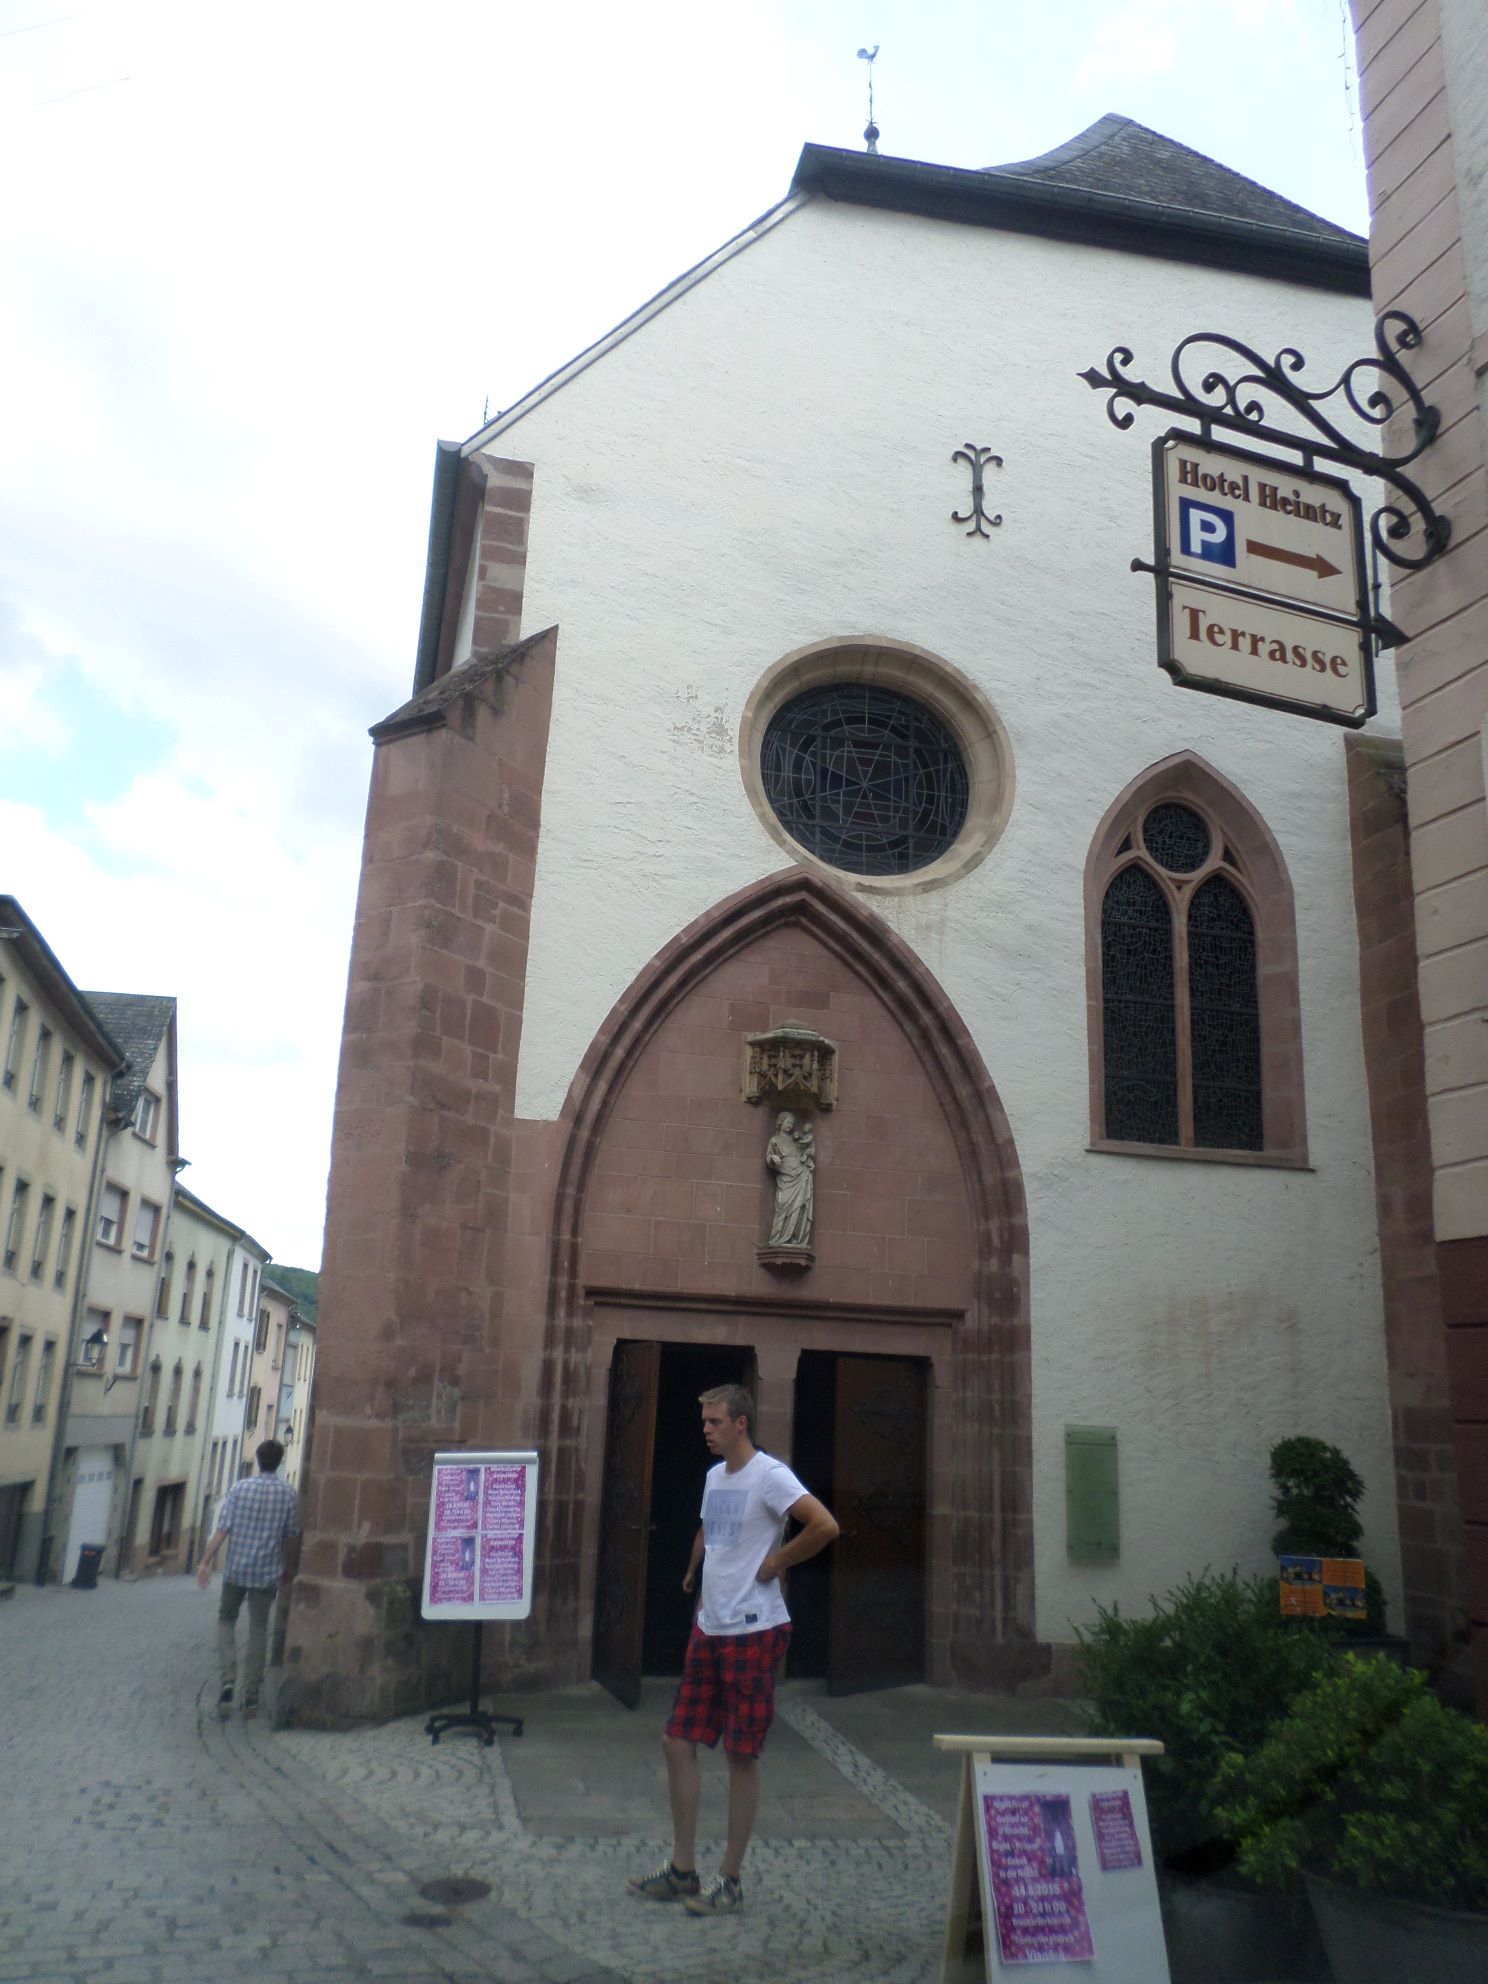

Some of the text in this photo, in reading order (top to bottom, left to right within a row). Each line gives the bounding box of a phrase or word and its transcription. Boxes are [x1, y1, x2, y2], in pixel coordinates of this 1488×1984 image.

[1178, 457, 1342, 530] Hotel Heintz
[1189, 507, 1227, 554] P
[1182, 604, 1349, 679] Terrasse
